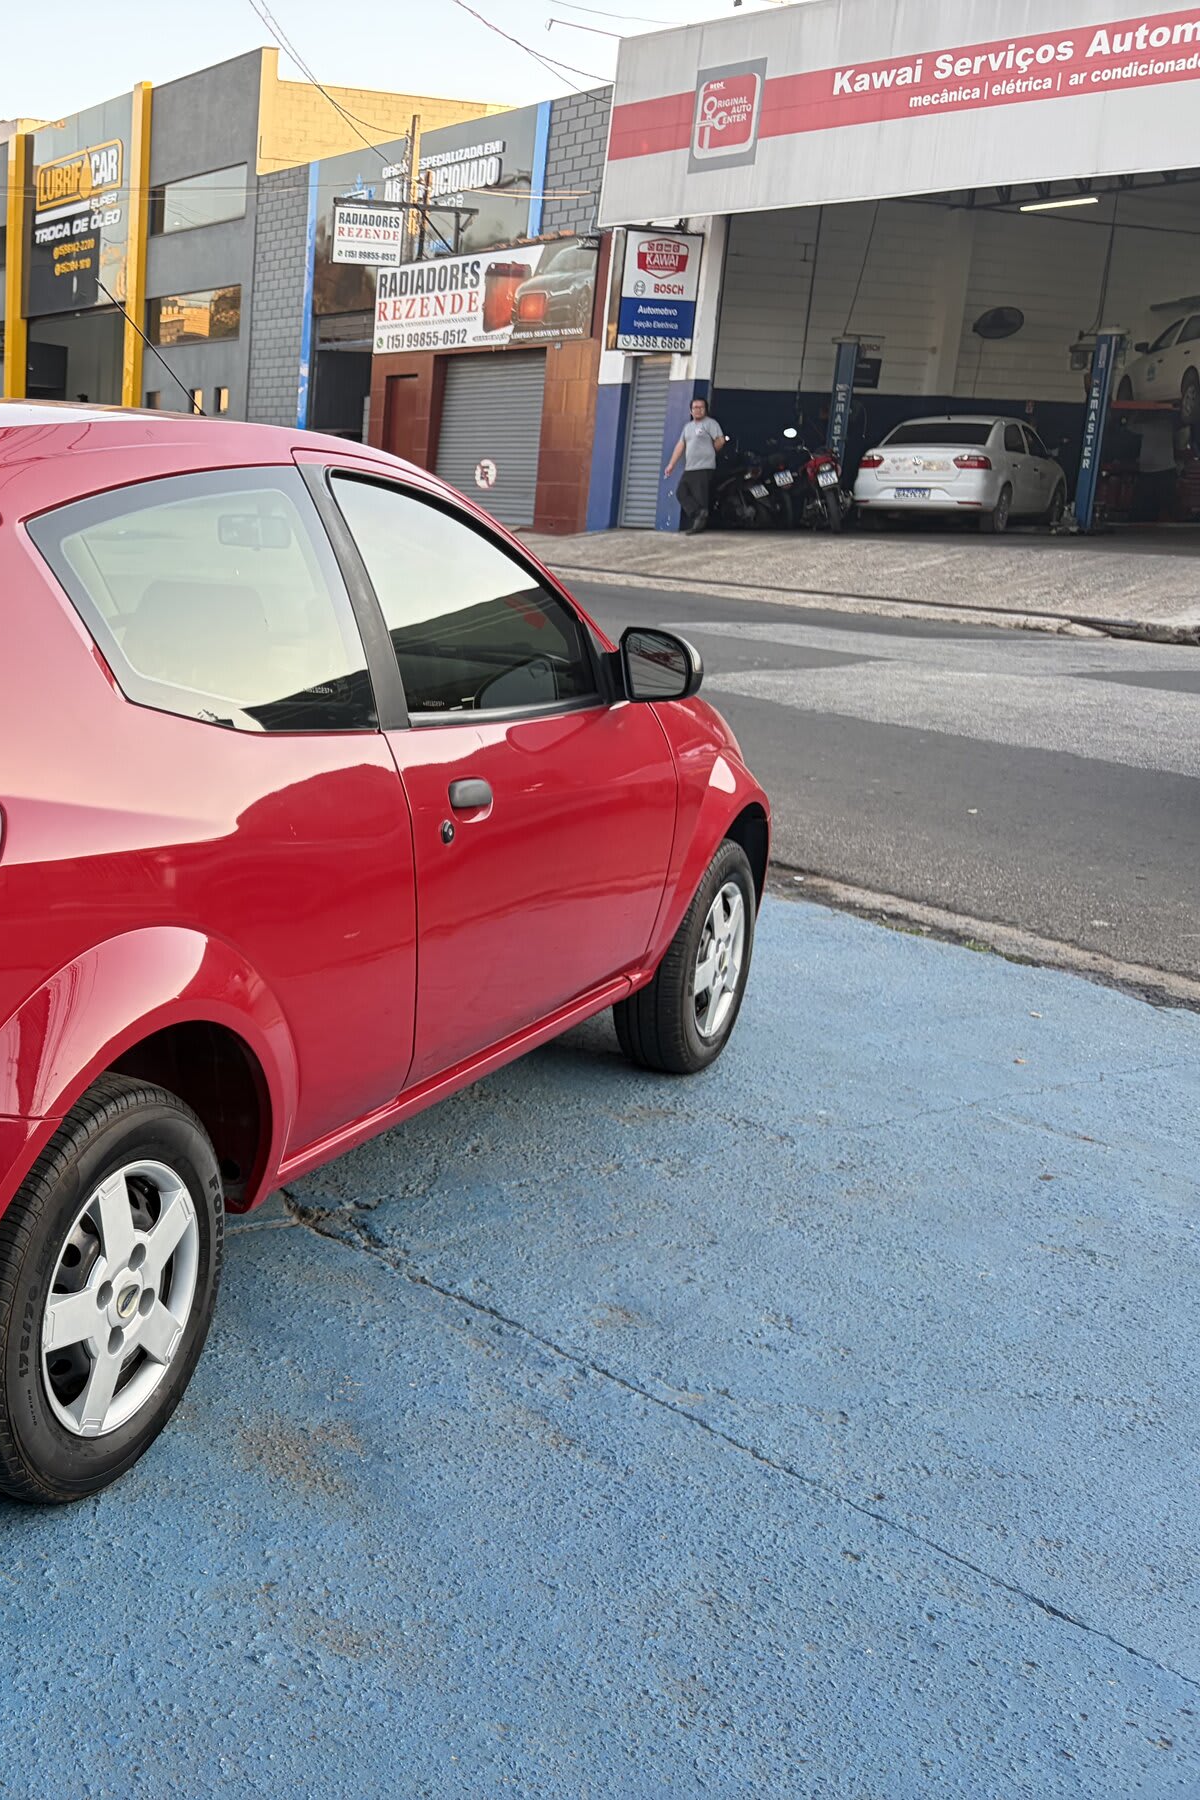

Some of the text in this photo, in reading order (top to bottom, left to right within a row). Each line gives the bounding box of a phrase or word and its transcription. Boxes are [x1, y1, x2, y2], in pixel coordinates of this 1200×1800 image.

[832, 60, 923, 96] Kawai
[933, 40, 1075, 74] Serviços
[909, 88, 981, 108] mecânica
[991, 77, 1052, 97] elétrica
[1069, 72, 1086, 86] ar
[730, 104, 752, 115] AUTO
[35, 209, 121, 244] TROCA DE ÓLEO
[338, 211, 400, 229] RADIADORES
[338, 226, 400, 241] REZENDE
[344, 250, 396, 262] (15) 99855-0512
[645, 253, 679, 267] KAWAI
[378, 260, 481, 299] RADIADORES
[653, 283, 684, 295] BOSCH
[377, 290, 480, 322] REZENDE
[386, 334, 405, 350] (15)
[406, 328, 467, 348] 99855-0512
